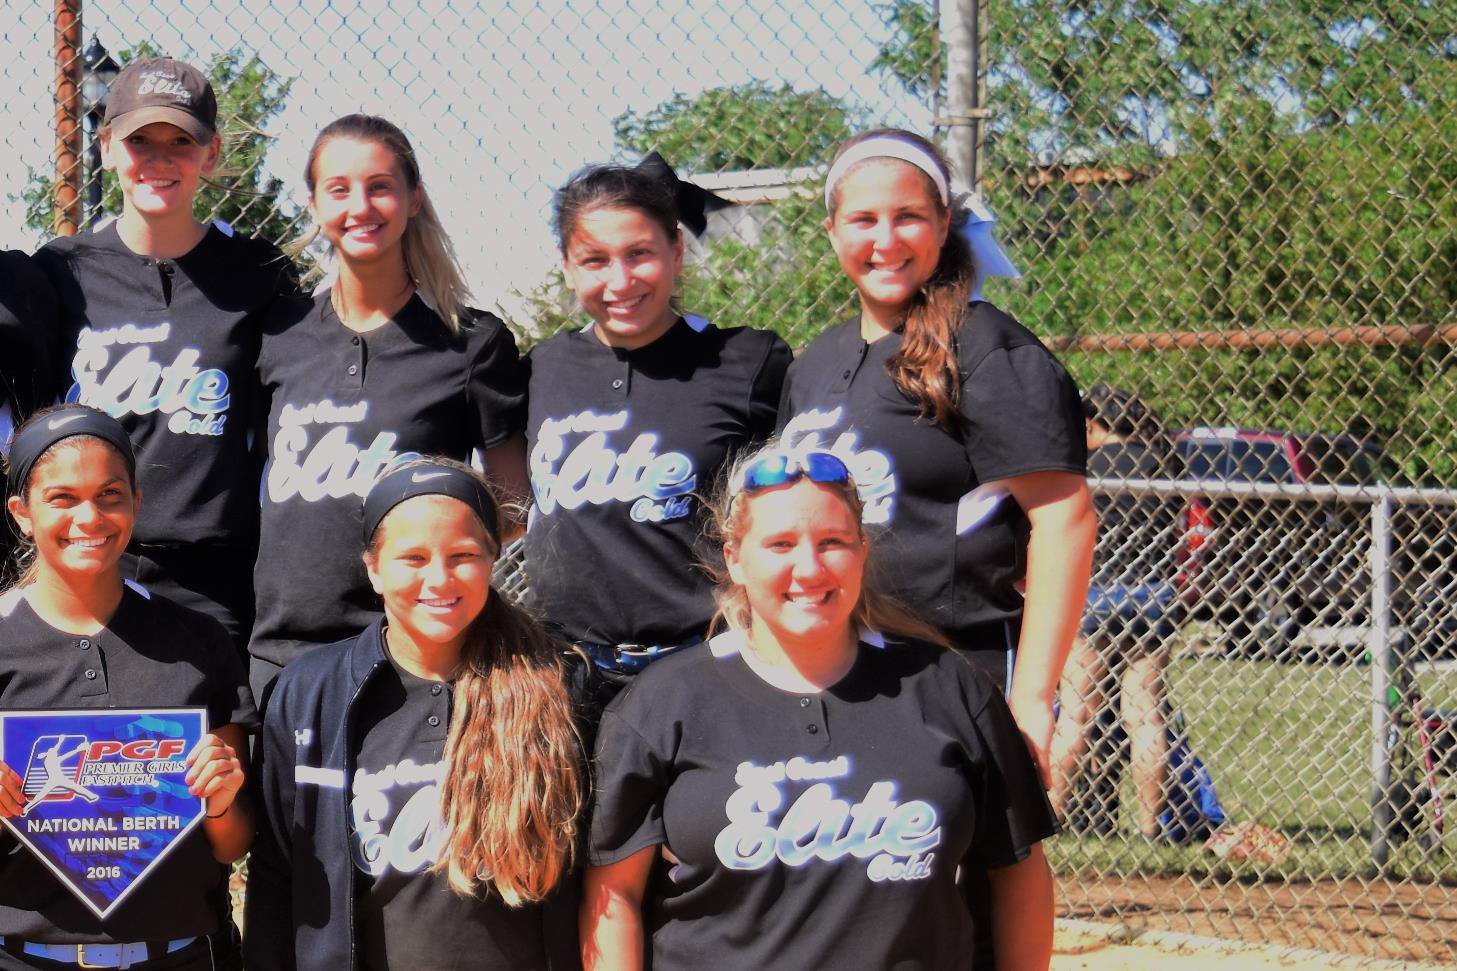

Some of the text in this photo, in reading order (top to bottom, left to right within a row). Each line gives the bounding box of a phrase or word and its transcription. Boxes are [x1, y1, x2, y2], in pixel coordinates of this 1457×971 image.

[168, 410, 227, 435] Gold
[630, 496, 692, 522] Gold
[87, 740, 186, 761] PGF
[83, 761, 187, 774] PREMIER GIRLS
[27, 816, 180, 832] NATIONAL BERTH
[714, 781, 941, 870] Elite
[67, 837, 140, 851] WINNER
[87, 866, 121, 878] 2016
[866, 853, 935, 882] Gold
